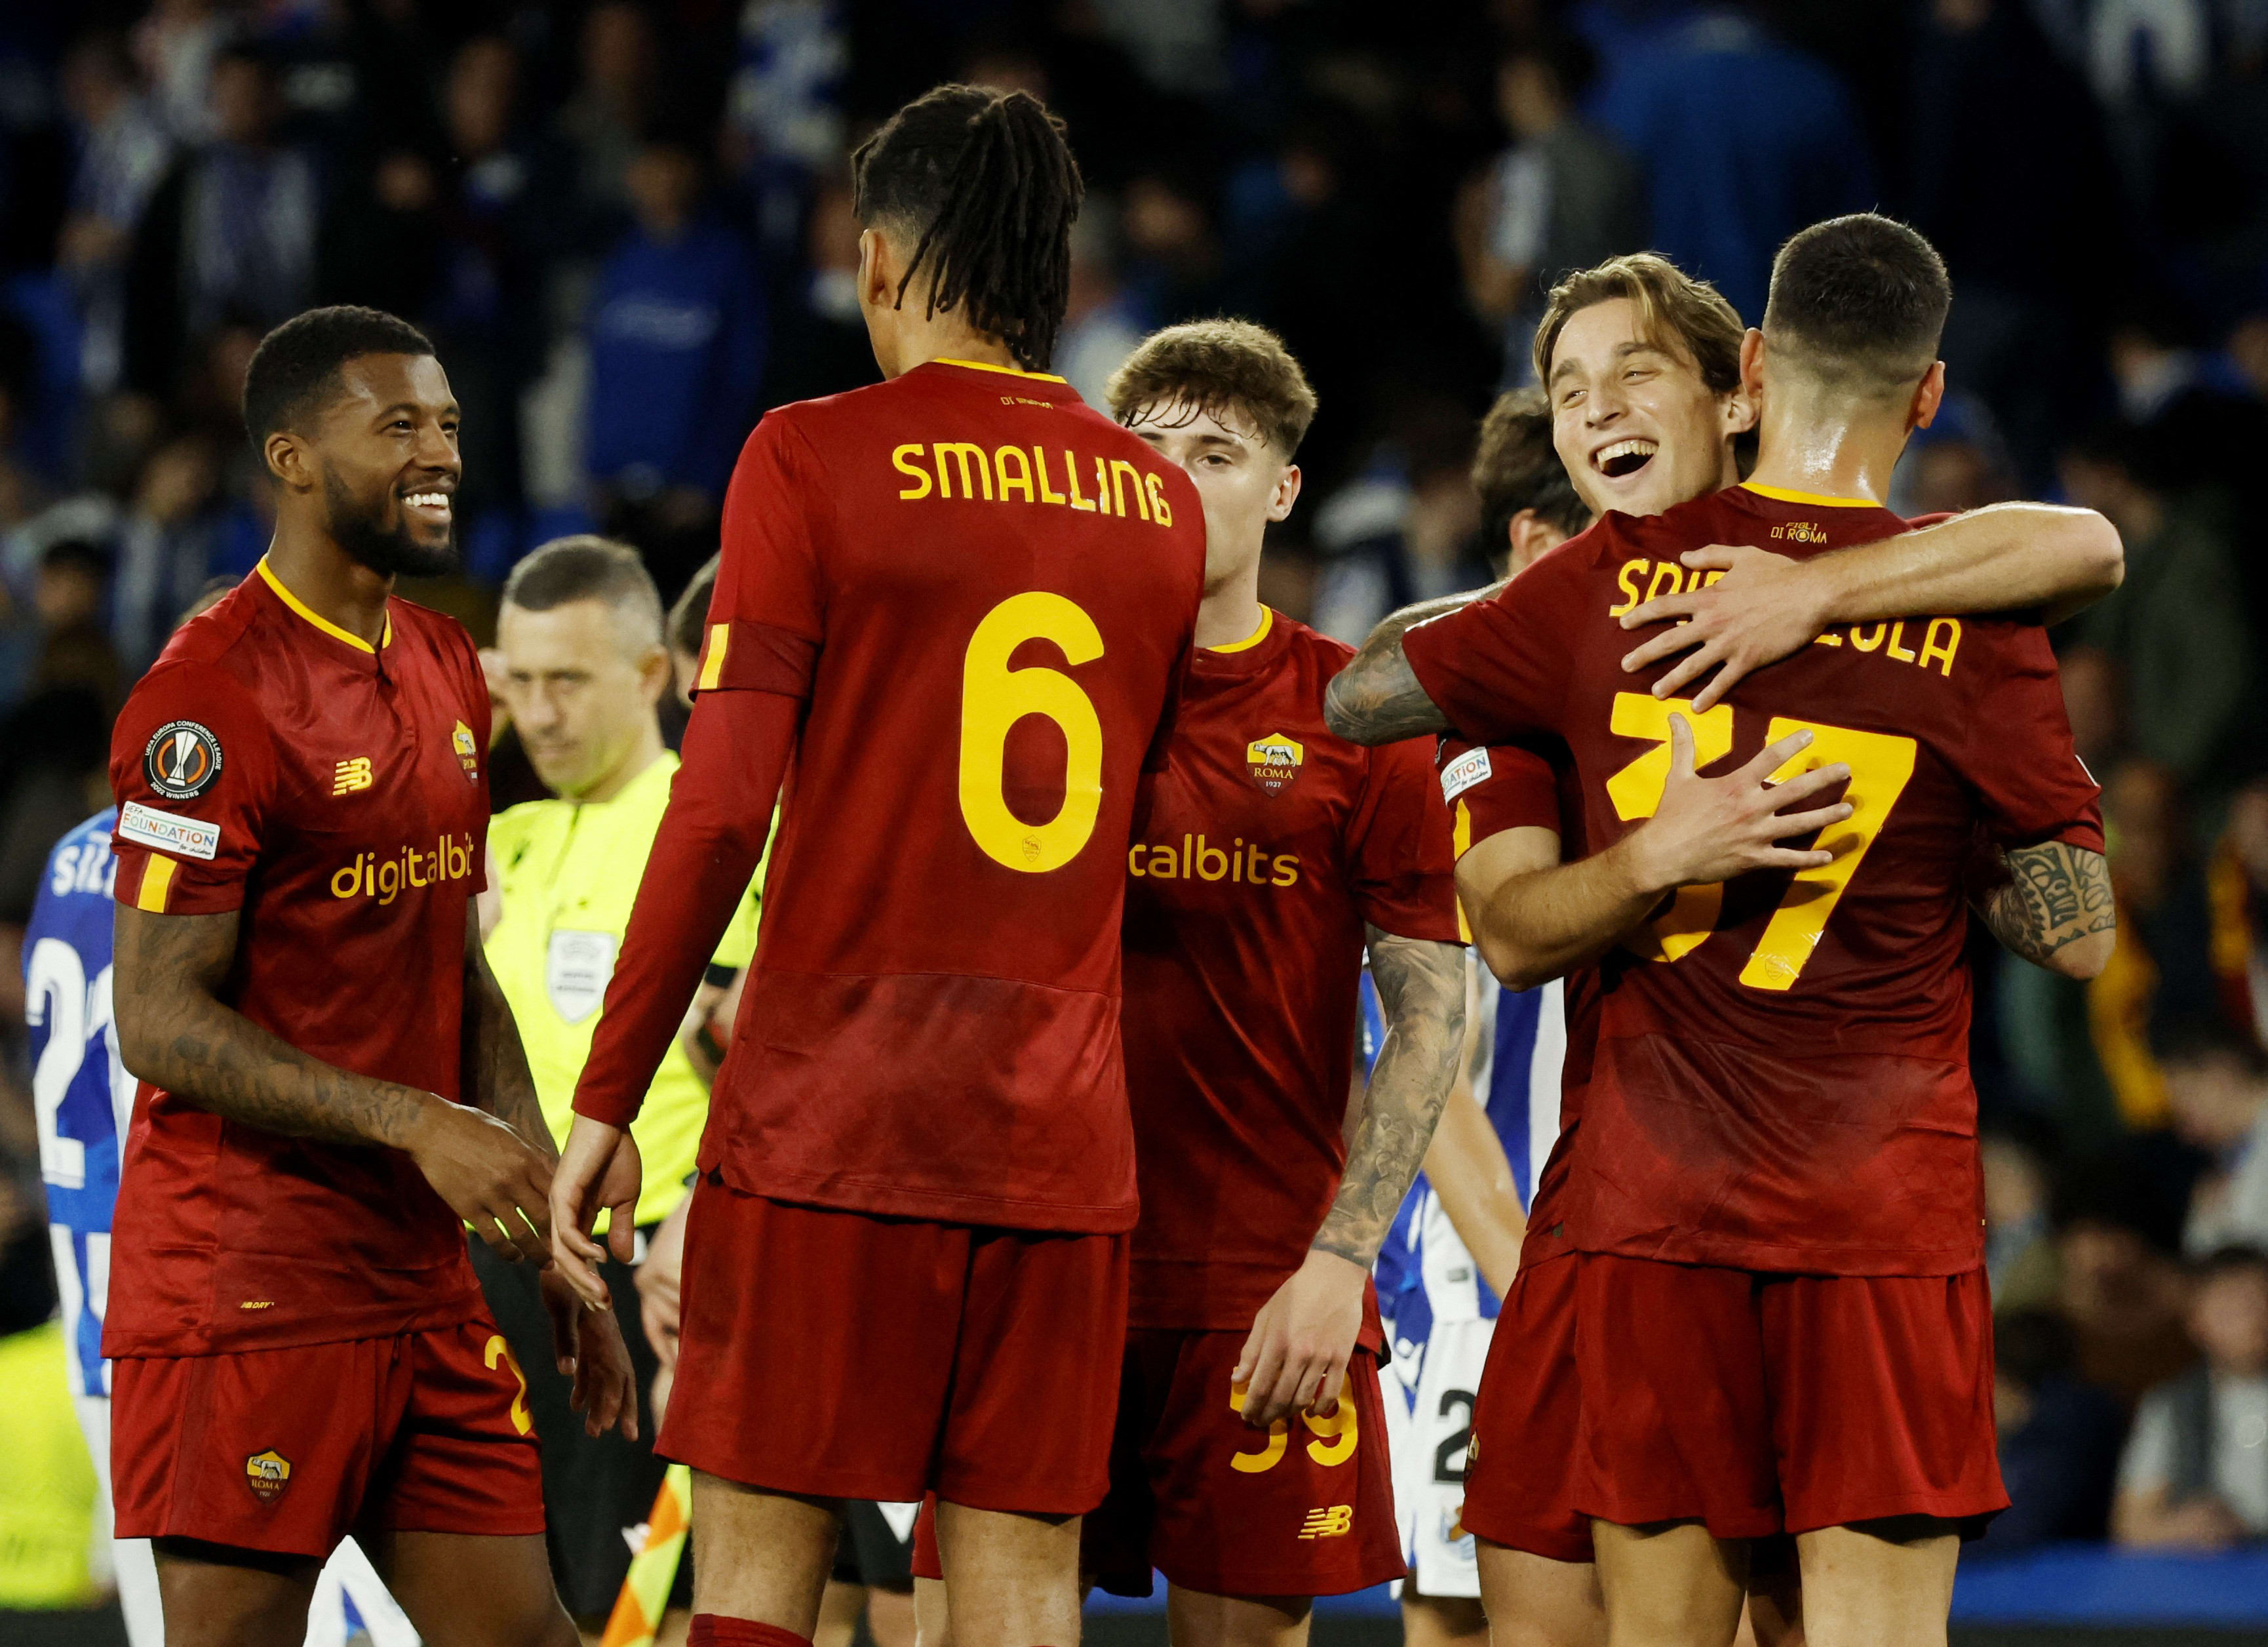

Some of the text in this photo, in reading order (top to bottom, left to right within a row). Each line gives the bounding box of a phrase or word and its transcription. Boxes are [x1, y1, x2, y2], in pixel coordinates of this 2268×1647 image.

[892, 443, 1173, 527] SMALLING
[1770, 526, 1827, 544] DI ROMA
[1786, 522, 1818, 531] FIGLI
[958, 591, 1105, 873] 6
[145, 721, 222, 770] UEFA EUROPA CONFERENCE LEAGUE
[1254, 767, 1294, 780] ROMA
[150, 782, 199, 799] 2022 WINNERS
[125, 804, 143, 814] UEFA
[1432, 1389, 1477, 1485] 2
